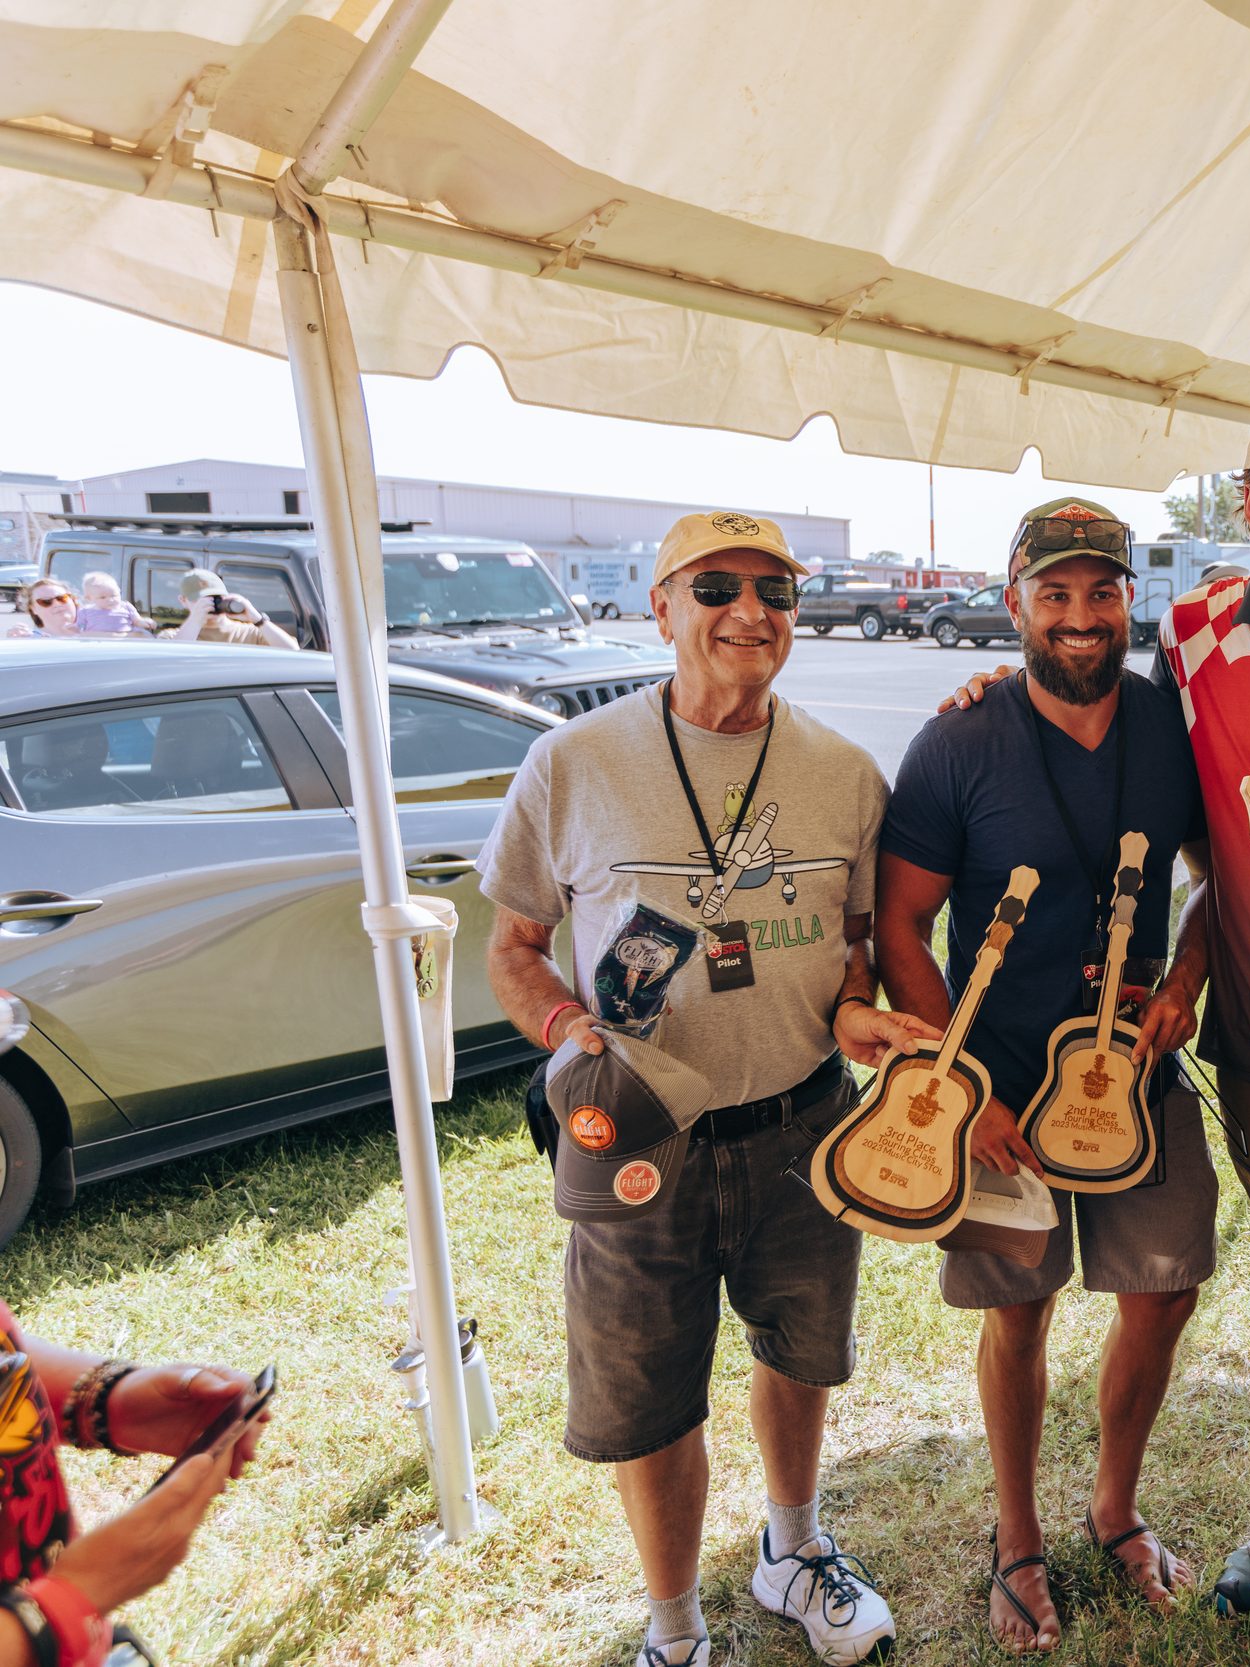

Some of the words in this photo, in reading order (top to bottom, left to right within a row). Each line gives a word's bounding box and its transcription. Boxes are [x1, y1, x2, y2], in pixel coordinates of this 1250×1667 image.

[722, 944, 747, 954] STOL
[718, 958, 742, 968] Pilot
[1067, 1104, 1087, 1116] 2nd
[1090, 1107, 1117, 1119] Place
[1064, 1113, 1095, 1126] Touring
[1097, 1117, 1118, 1127] Class
[574, 1124, 608, 1136] FLIGHT
[1071, 1122, 1092, 1131] Music
[1109, 1127, 1128, 1135] STOL
[885, 1126, 905, 1140] 3rd
[906, 1135, 936, 1154] Place
[879, 1134, 911, 1155] Touring
[913, 1149, 936, 1164] Class
[862, 1139, 882, 1152] 2023
[883, 1146, 906, 1160] Music
[907, 1157, 924, 1169] City
[924, 1161, 943, 1176] STOL
[622, 1177, 654, 1188] FLIGHT
[889, 1176, 908, 1188] STOL
